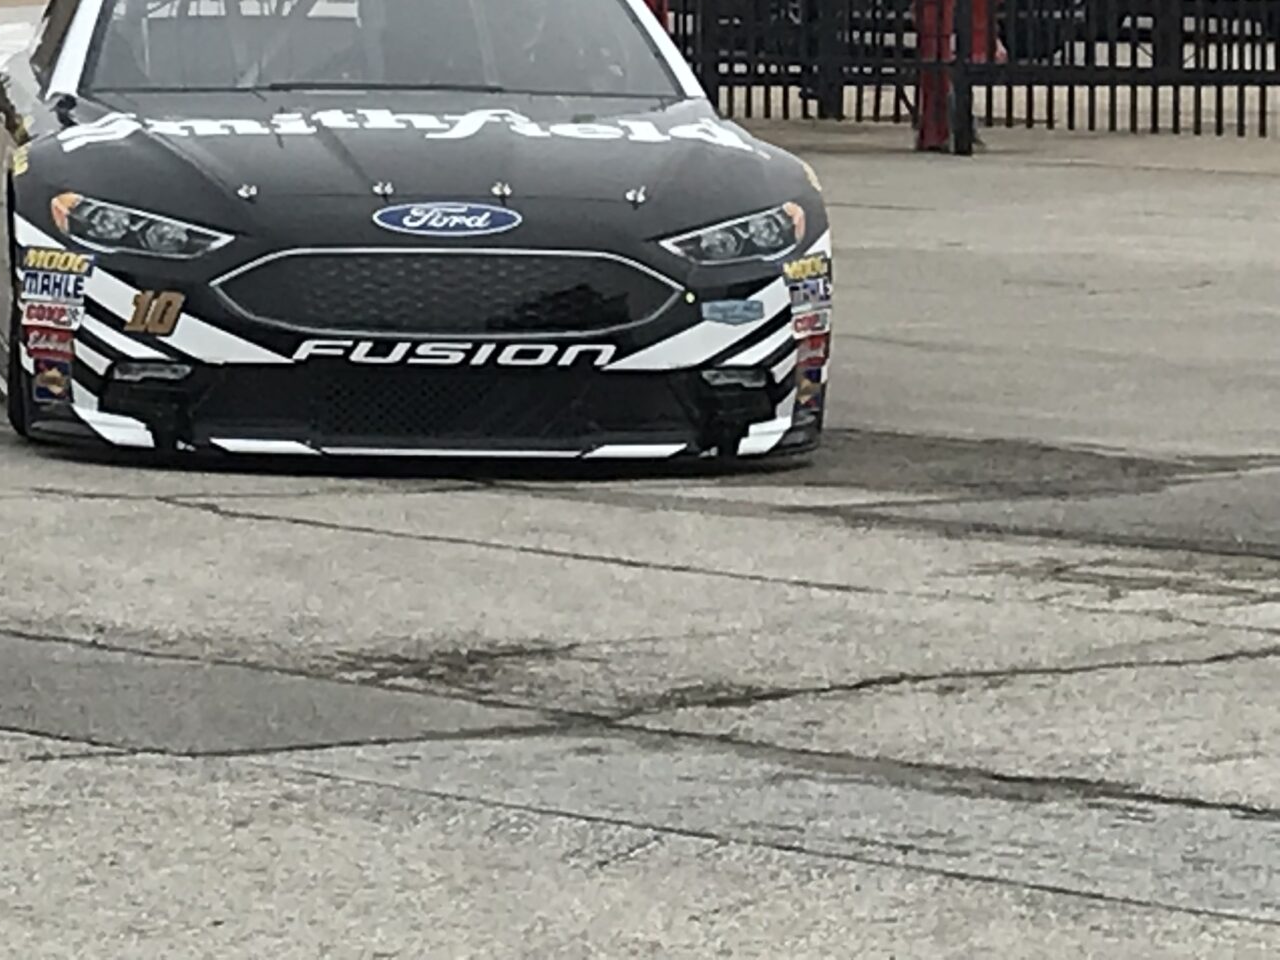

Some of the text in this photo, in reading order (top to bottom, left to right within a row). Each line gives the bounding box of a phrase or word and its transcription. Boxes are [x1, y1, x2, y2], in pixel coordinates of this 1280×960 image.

[402, 206, 492, 228] Ford
[24, 248, 93, 274] MOOG
[24, 271, 85, 298] MAHLE
[124, 289, 187, 337] 10
[293, 339, 617, 367] FUSION
